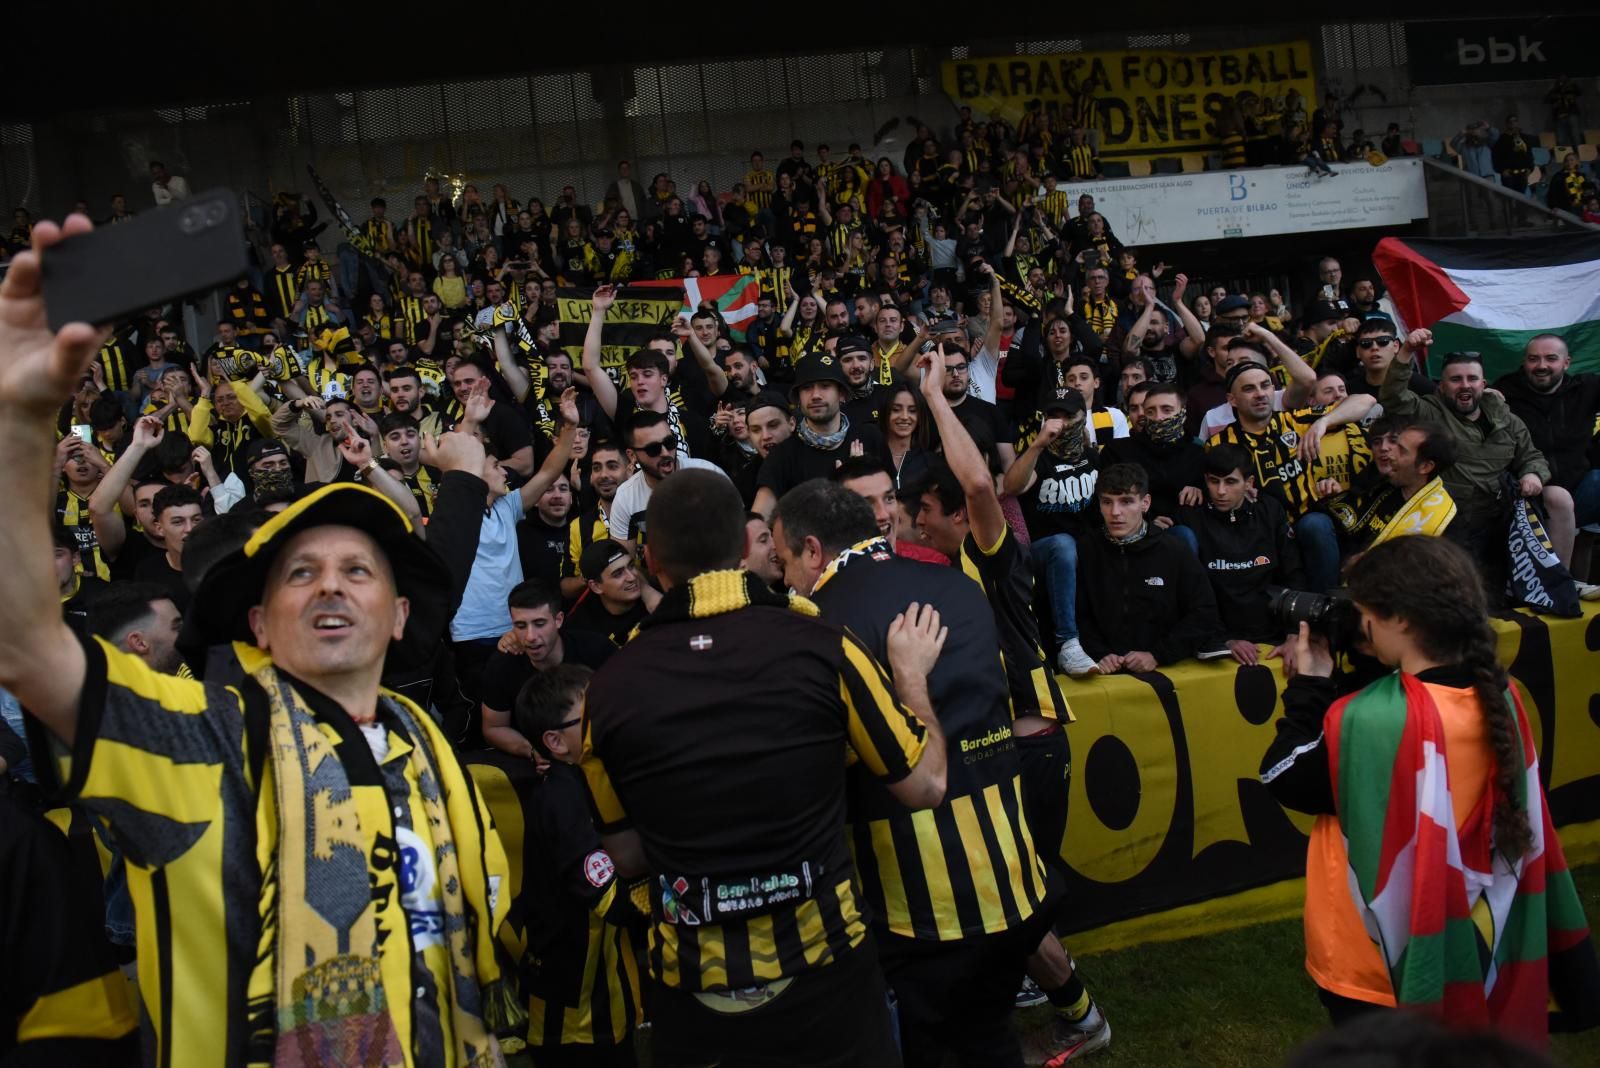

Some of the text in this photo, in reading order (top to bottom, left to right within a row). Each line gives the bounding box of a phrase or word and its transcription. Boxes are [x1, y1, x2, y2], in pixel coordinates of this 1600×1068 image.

[1457, 35, 1547, 65] bbk
[1121, 47, 1309, 90] FOOTBALL
[1197, 207, 1230, 216] PUERTA
[1246, 203, 1278, 213] BILBAO
[567, 300, 677, 328] CHRRERIA
[1278, 459, 1304, 483] SCA
[1207, 558, 1254, 570] ellesse
[960, 725, 1012, 753] Barakaldo
